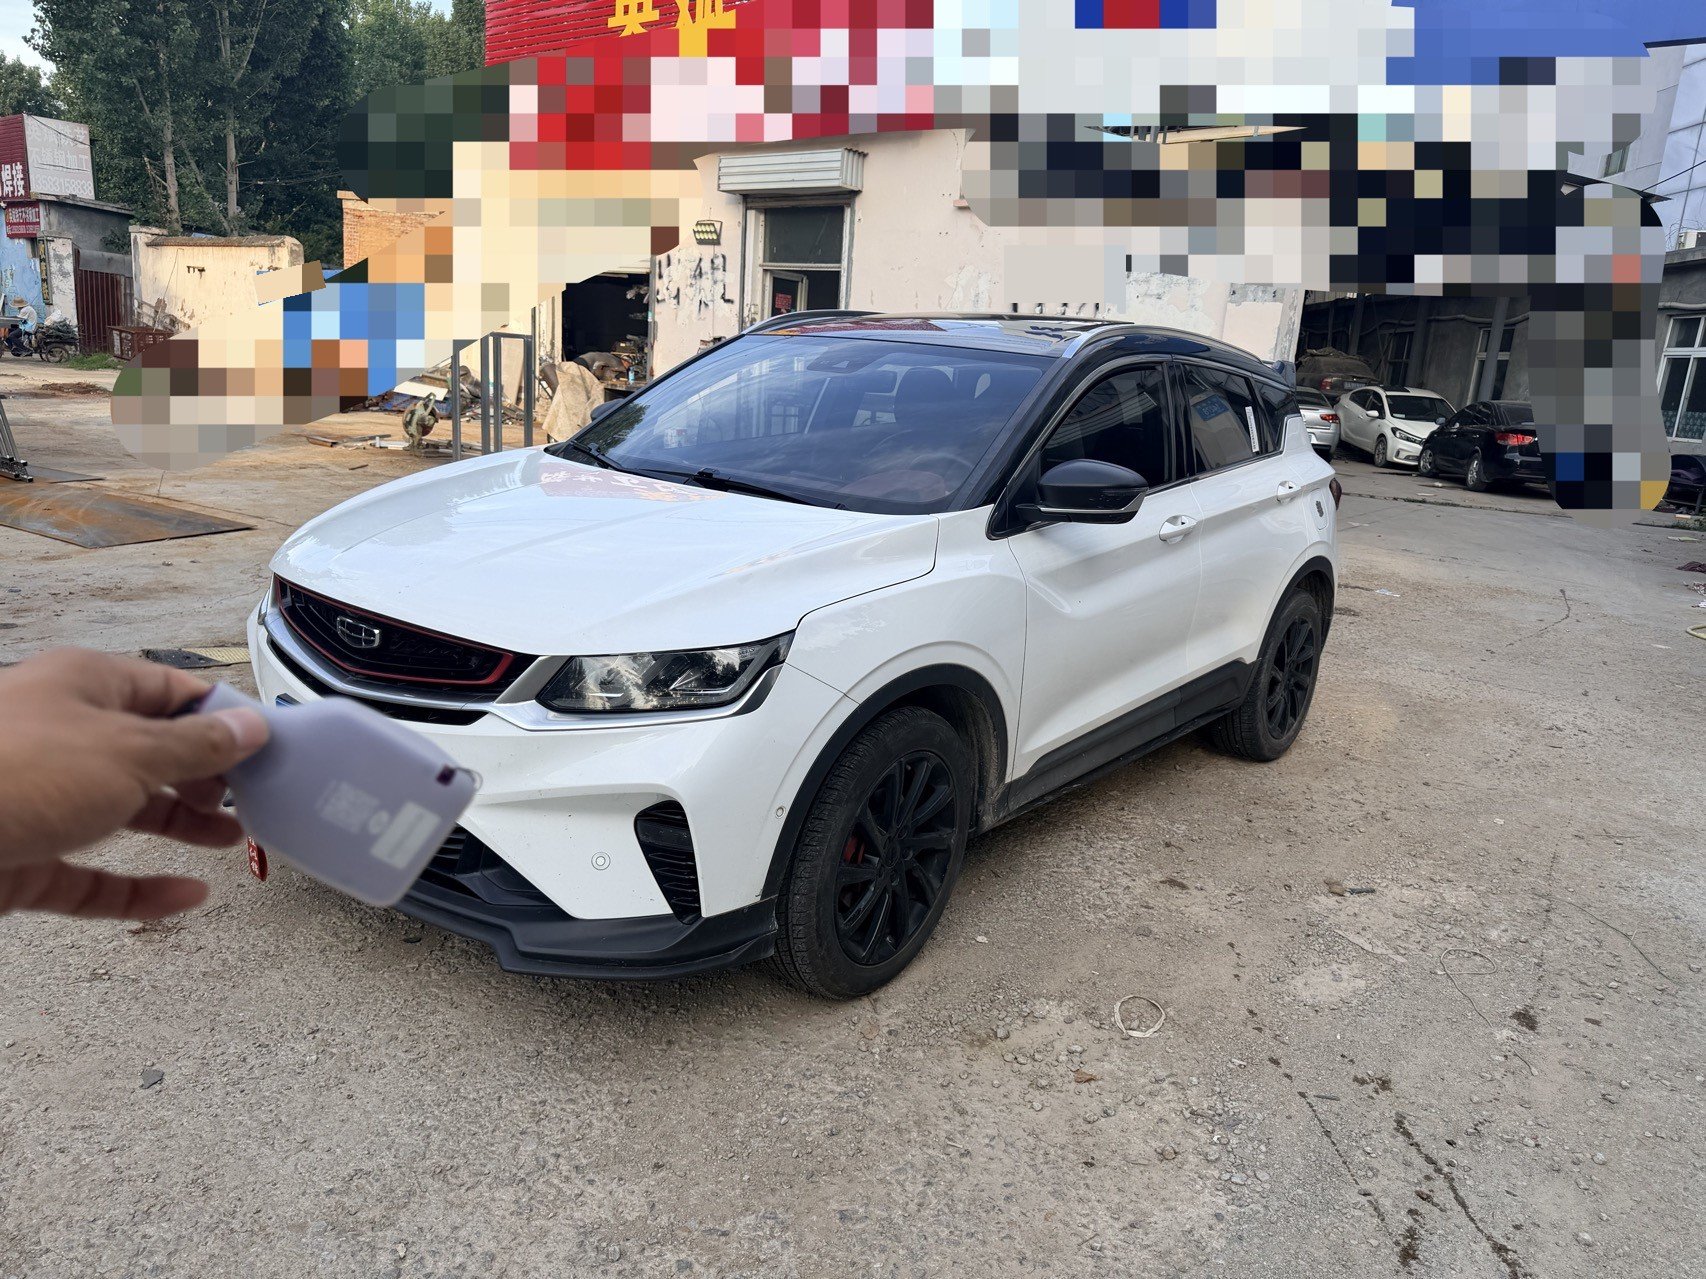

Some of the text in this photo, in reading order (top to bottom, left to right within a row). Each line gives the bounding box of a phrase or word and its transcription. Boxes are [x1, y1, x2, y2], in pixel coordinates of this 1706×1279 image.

[28, 147, 89, 170] 不锈钢加工
